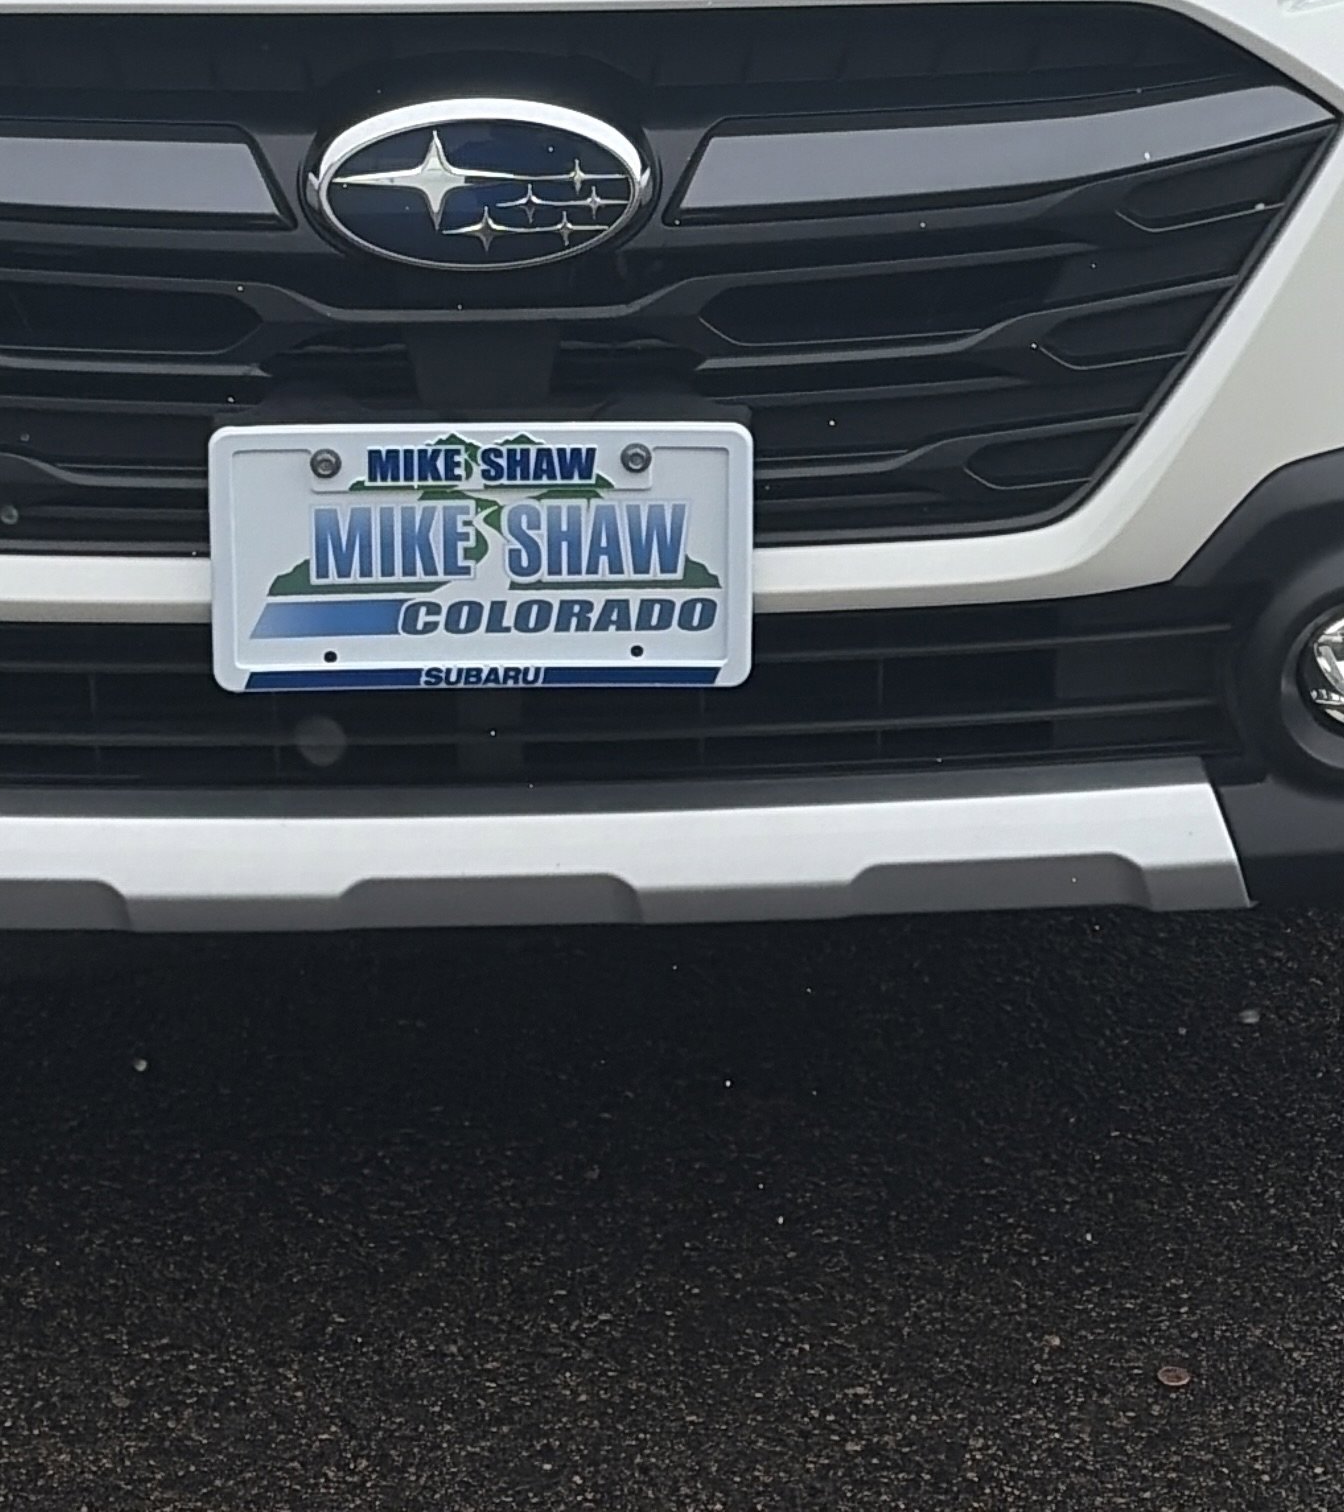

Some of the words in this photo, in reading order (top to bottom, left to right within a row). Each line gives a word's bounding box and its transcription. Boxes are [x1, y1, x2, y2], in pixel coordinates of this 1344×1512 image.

[367, 449, 463, 482] MIKE
[480, 448, 596, 481] SHAW
[313, 505, 473, 579] MIKE
[507, 503, 687, 577] SHAW
[400, 598, 717, 635] COLORADO
[423, 667, 542, 686] SUBARU
